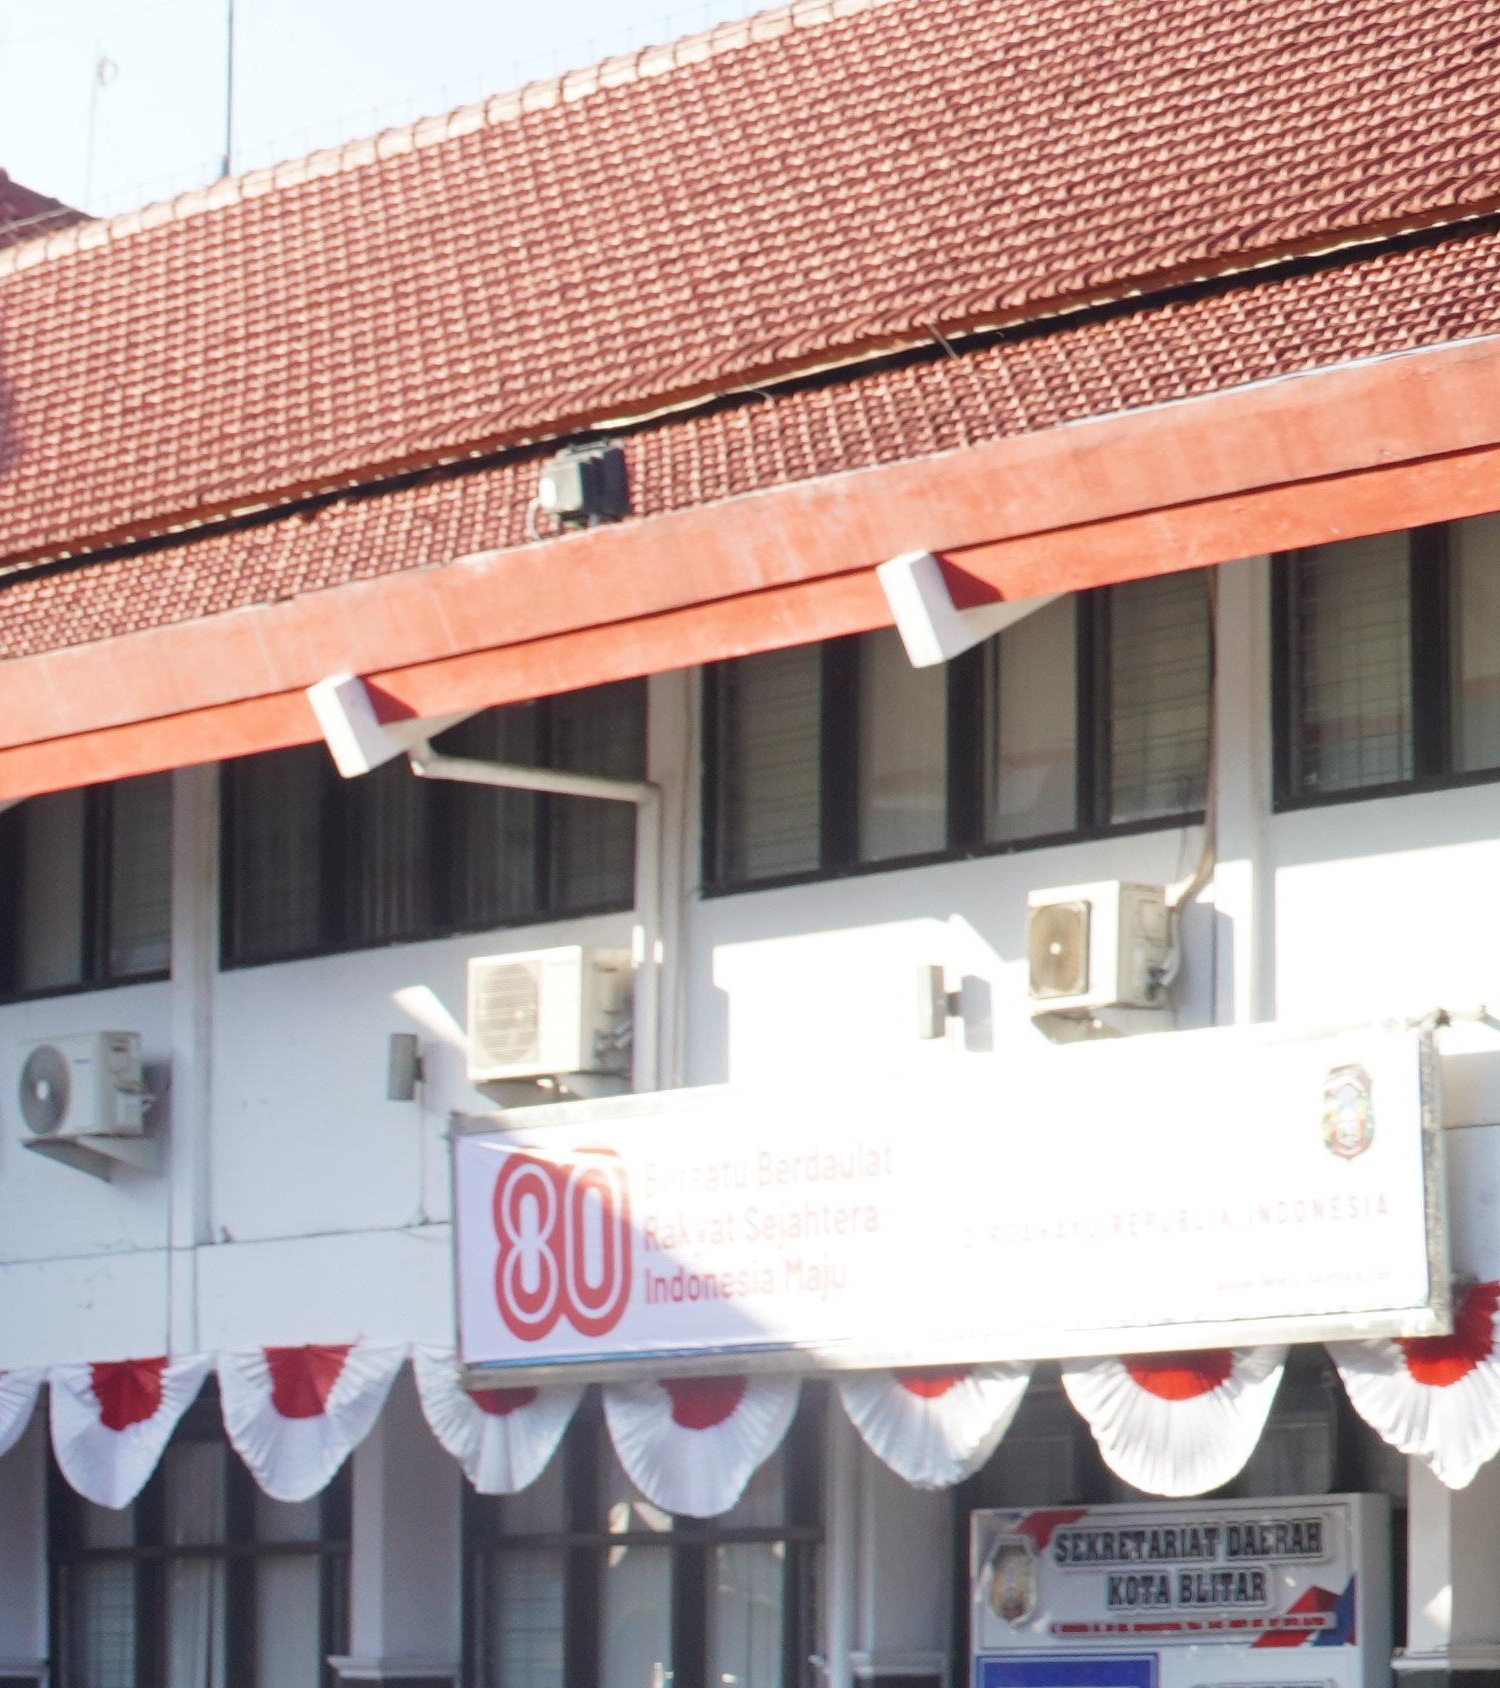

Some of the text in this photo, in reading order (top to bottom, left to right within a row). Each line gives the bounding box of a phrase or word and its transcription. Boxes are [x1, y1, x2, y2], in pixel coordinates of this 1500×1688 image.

[644, 1143, 893, 1199] Bersatu Berdaulat
[492, 1142, 633, 1342] 80
[643, 1202, 880, 1259] Rakyat Sejahtera
[962, 1192, 1391, 1250] DRGAHAYU REPUBLIK INDONESIA
[644, 1253, 848, 1306] Indonesia Maju
[1054, 1518, 1323, 1563] SEKRETARIAT DAERAH
[1107, 1570, 1267, 1606] KOTA BLITAR
